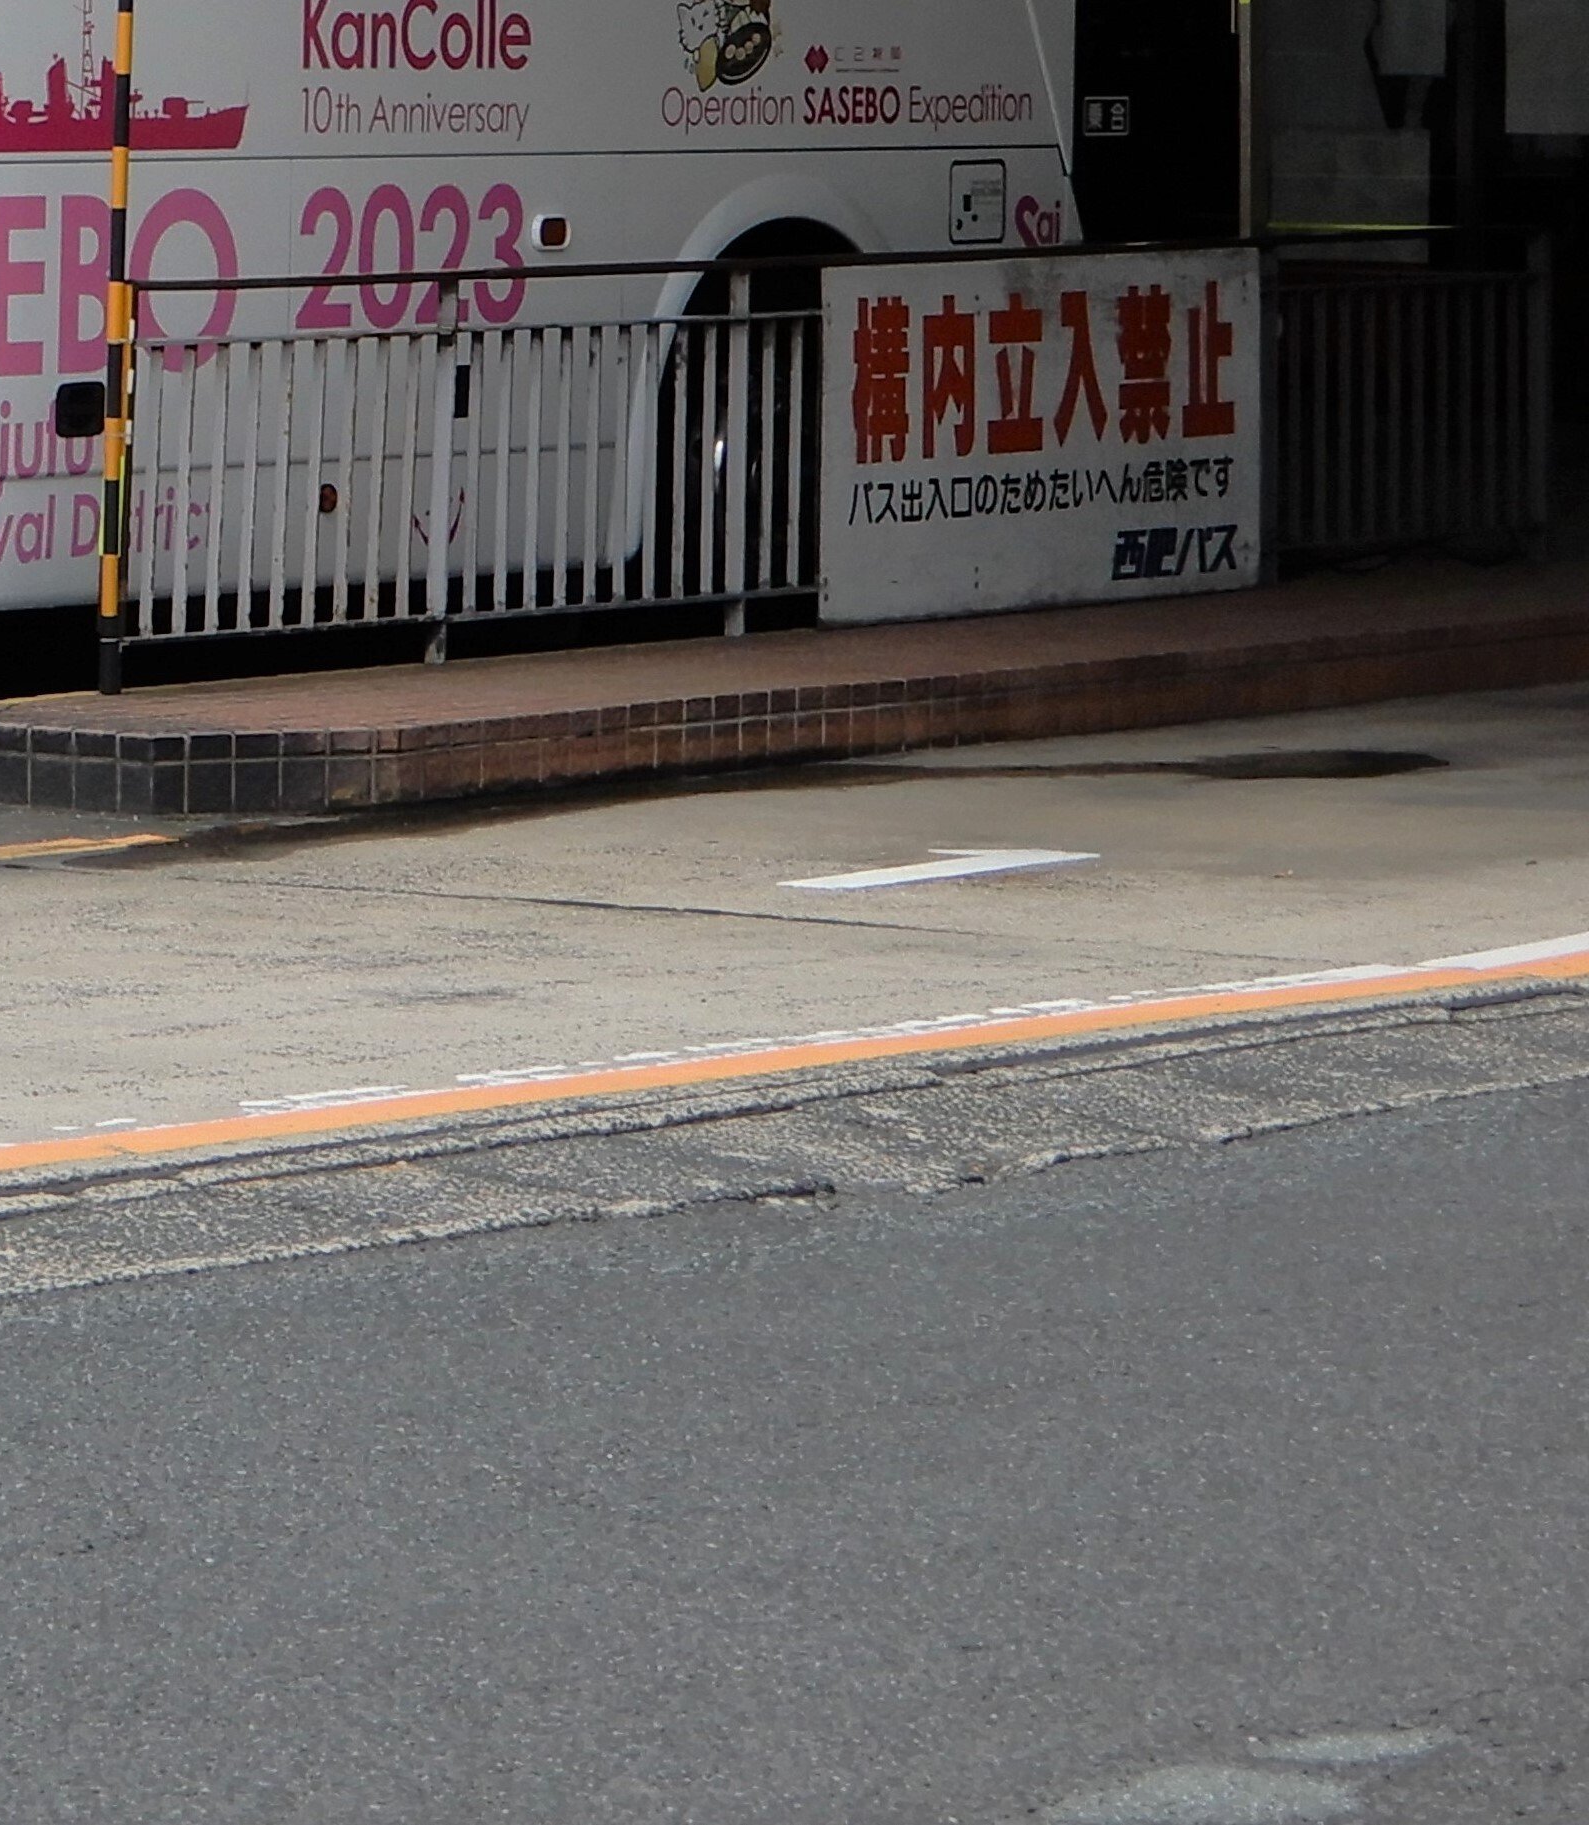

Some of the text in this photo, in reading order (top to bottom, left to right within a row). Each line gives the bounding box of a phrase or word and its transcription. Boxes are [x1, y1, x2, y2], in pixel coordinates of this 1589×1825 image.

[301, 86, 530, 142] 10th Anniversary
[661, 83, 1033, 134] Operation SASEBO Expedition
[295, 182, 527, 329] 2023
[852, 280, 1235, 464] 構内立入禁止
[848, 456, 1234, 526] バス出入口のためたいへん危険です
[1111, 524, 1238, 581] 西肥バス
